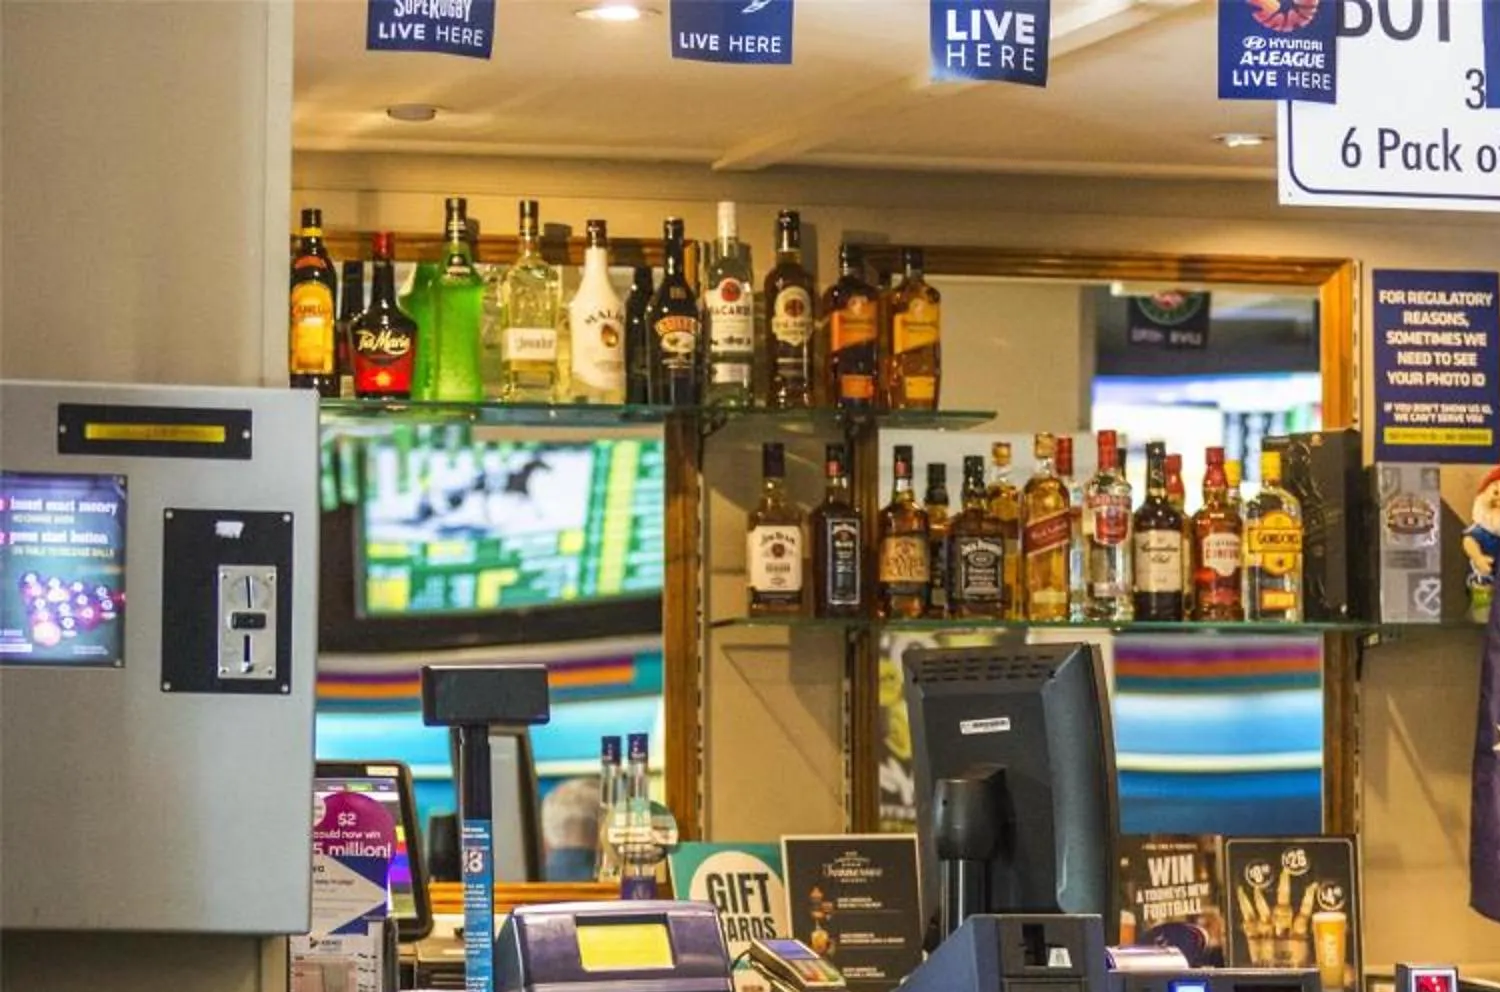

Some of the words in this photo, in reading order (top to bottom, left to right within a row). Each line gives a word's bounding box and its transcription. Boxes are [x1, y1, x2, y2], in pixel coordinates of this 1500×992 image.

[379, 22, 426, 40] LIVE
[436, 25, 484, 47] HERE
[946, 9, 1036, 45] LIVE
[680, 32, 719, 51] LIVE
[729, 35, 782, 54] HERE
[1269, 38, 1323, 51] HYUNDAI
[946, 44, 1036, 72] HERE
[1240, 51, 1326, 69] A-LEAGUE
[1232, 70, 1278, 87] LIVE
[1287, 71, 1332, 90] HERE
[1465, 69, 1485, 109] 3
[1341, 127, 1362, 169] 6
[1378, 128, 1463, 172] Pack
[1379, 290, 1406, 304] FOR
[1407, 290, 1494, 307] REGULATORY
[1403, 311, 1470, 328] REASONS,
[1386, 331, 1462, 347] SOMETIMES
[1463, 333, 1488, 347] WE
[1397, 352, 1433, 366] NEED
[1434, 353, 1452, 366] TO
[1453, 353, 1478, 367] SEE
[1387, 371, 1424, 386] YOUR
[1425, 372, 1469, 387] PHOTO
[1471, 373, 1486, 387] ID
[337, 811, 357, 827] $2
[1147, 853, 1195, 888] WIN
[706, 872, 769, 914] GIFT
[1143, 896, 1202, 922] FOOTBALL
[723, 915, 777, 942] ARDS
